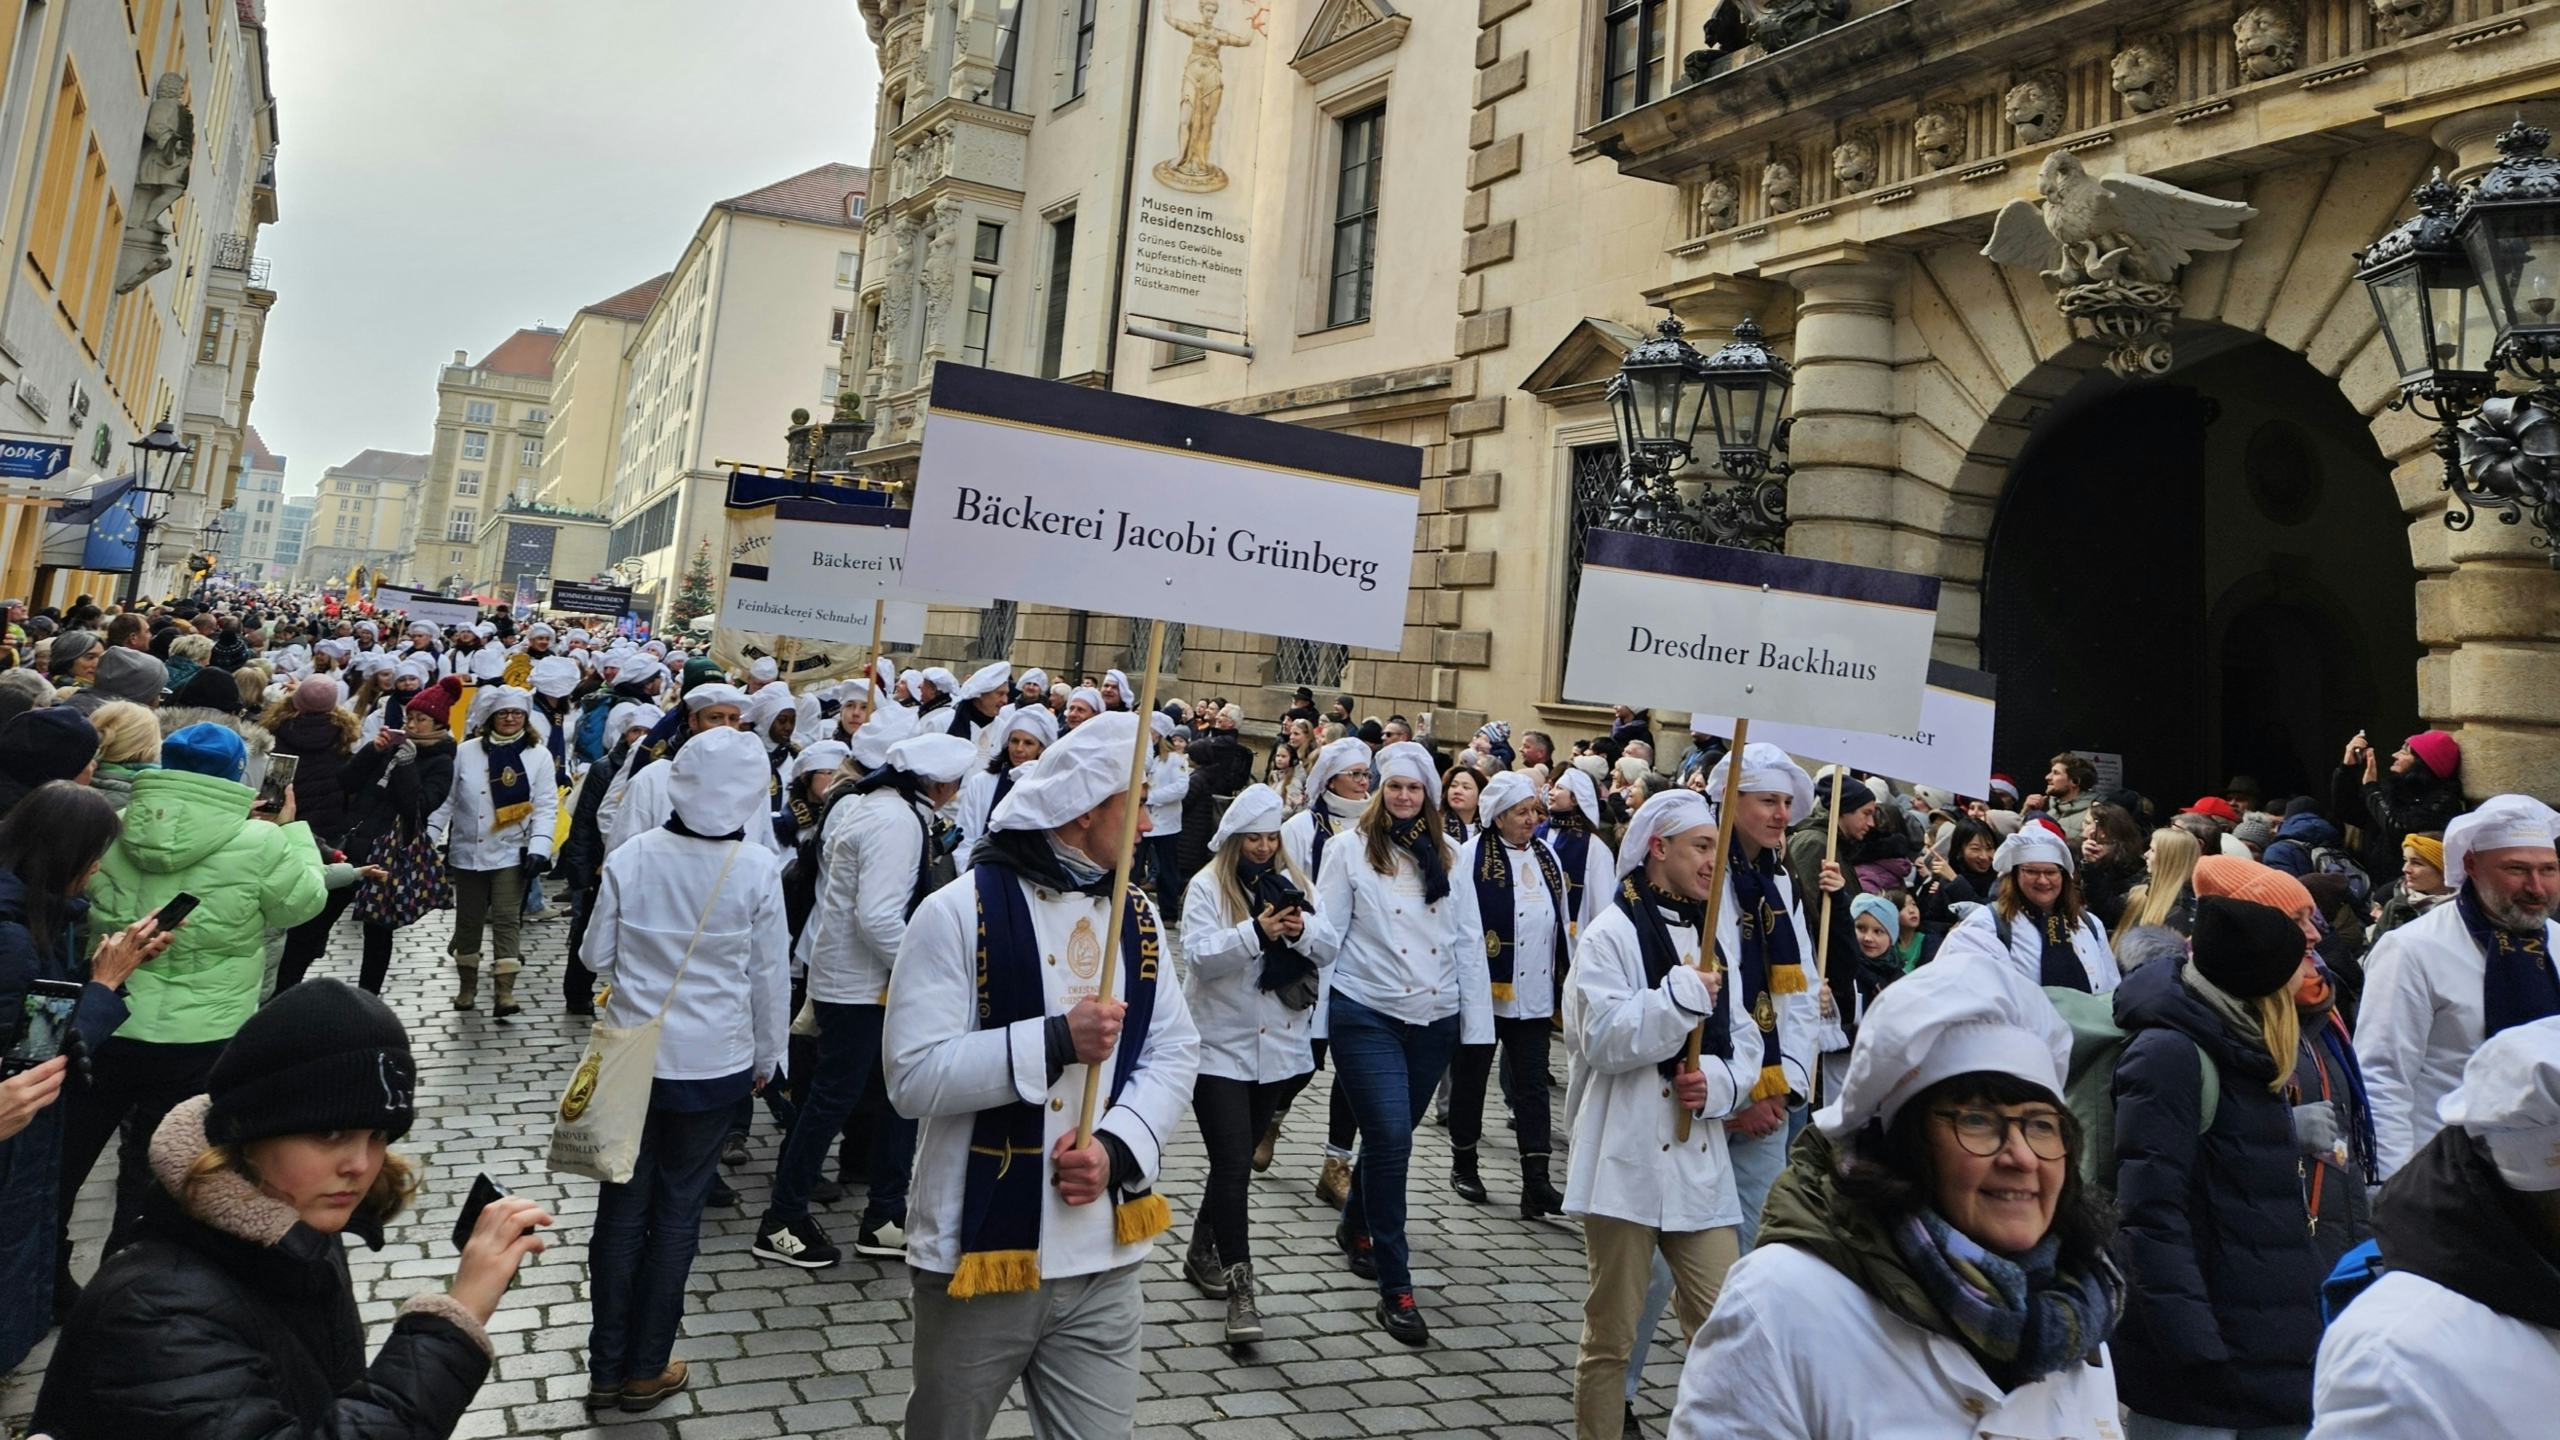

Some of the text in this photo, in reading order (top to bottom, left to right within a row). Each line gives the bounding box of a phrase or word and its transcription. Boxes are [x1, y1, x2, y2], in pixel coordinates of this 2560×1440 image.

[1141, 196, 1213, 221] Museen im
[1140, 211, 1245, 244] Residenzschloss
[1138, 232, 1223, 257] Grünes Gewölbe
[1135, 261, 1207, 284] Münzkabinett
[1137, 247, 1243, 277] Kupferstich-Kabinett
[1134, 276, 1201, 297] Rüstkammer
[952, 486, 1380, 592] Bäckerei Jacobi Grünberg
[812, 551, 882, 571] Bäckerei
[594, 595, 624, 603] DRESDEN
[737, 599, 868, 626] Feinbäckerei Schnabel
[1627, 625, 1877, 682] Dresdner Backhaus
